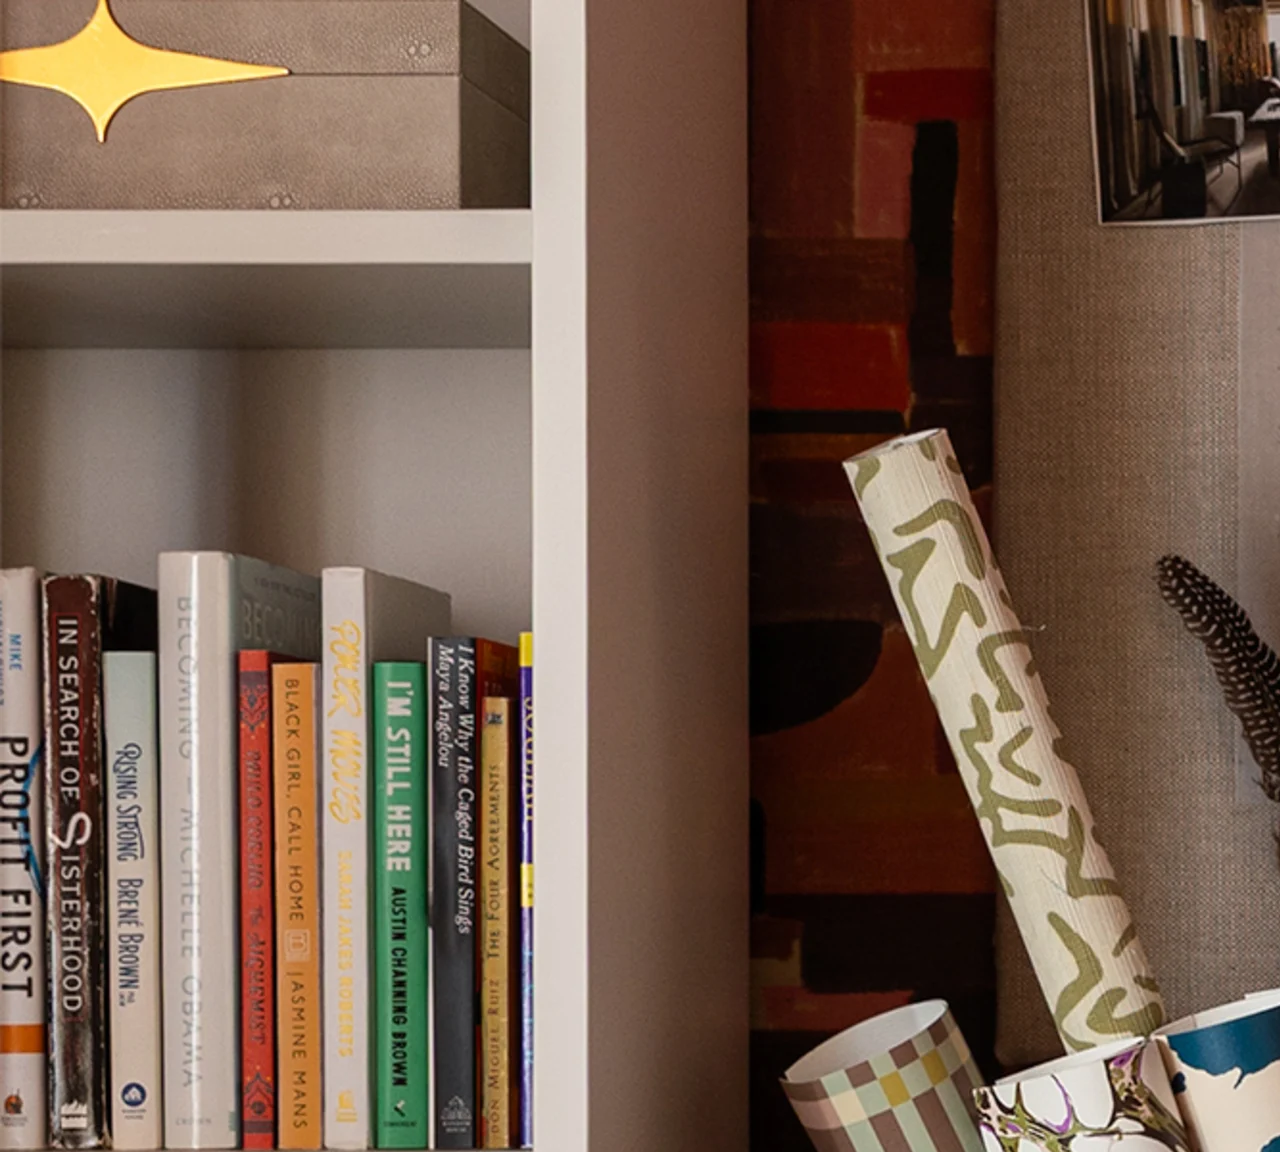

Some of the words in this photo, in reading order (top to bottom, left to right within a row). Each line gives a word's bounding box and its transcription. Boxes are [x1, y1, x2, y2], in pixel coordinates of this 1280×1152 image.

[9, 633, 23, 671] MIKE
[58, 619, 79, 645] IN
[458, 643, 475, 654] I
[177, 596, 199, 760] BECOMING
[327, 619, 363, 718] POWER
[435, 643, 455, 693] Maya
[458, 656, 475, 711] Know
[58, 655, 80, 757] SEARCH
[284, 678, 301, 740] BLACK
[387, 681, 415, 717] I'M
[435, 695, 455, 768] Angelou
[454, 713, 475, 752] Why
[113, 743, 143, 800] RISING
[285, 748, 302, 799] GIRL,
[328, 729, 363, 825] MOVES
[386, 726, 412, 797] STILL
[458, 755, 475, 784] the
[0, 737, 31, 873] PROFIT
[116, 804, 145, 863] STRONG
[287, 806, 303, 856] CALL
[454, 788, 475, 841] Caged
[487, 764, 500, 871] AGREEMENTS
[386, 804, 412, 872] HERE
[458, 844, 475, 885] Bird
[117, 878, 145, 928] BRENÉ
[180, 807, 203, 959] MICHELLE
[289, 865, 305, 921] HOME
[337, 850, 353, 910] SARAH
[487, 878, 500, 921] FOUR
[49, 811, 92, 1012] SISTERHOOD
[391, 886, 408, 942] AUSTIN
[454, 887, 475, 935] Sings
[0, 888, 34, 998] FIRST
[117, 932, 145, 990] BROWN
[337, 914, 353, 971] JAKES
[487, 931, 500, 959] THE
[391, 946, 409, 1026] CHANNING
[487, 978, 500, 1016] RUIZ
[181, 974, 204, 1088] OBAMA
[286, 972, 308, 1060] JASMINE
[337, 976, 355, 1057] ROBERTS
[391, 1031, 409, 1087] BROWN
[487, 1028, 500, 1089] MIGUEL
[292, 1070, 308, 1130] MANS
